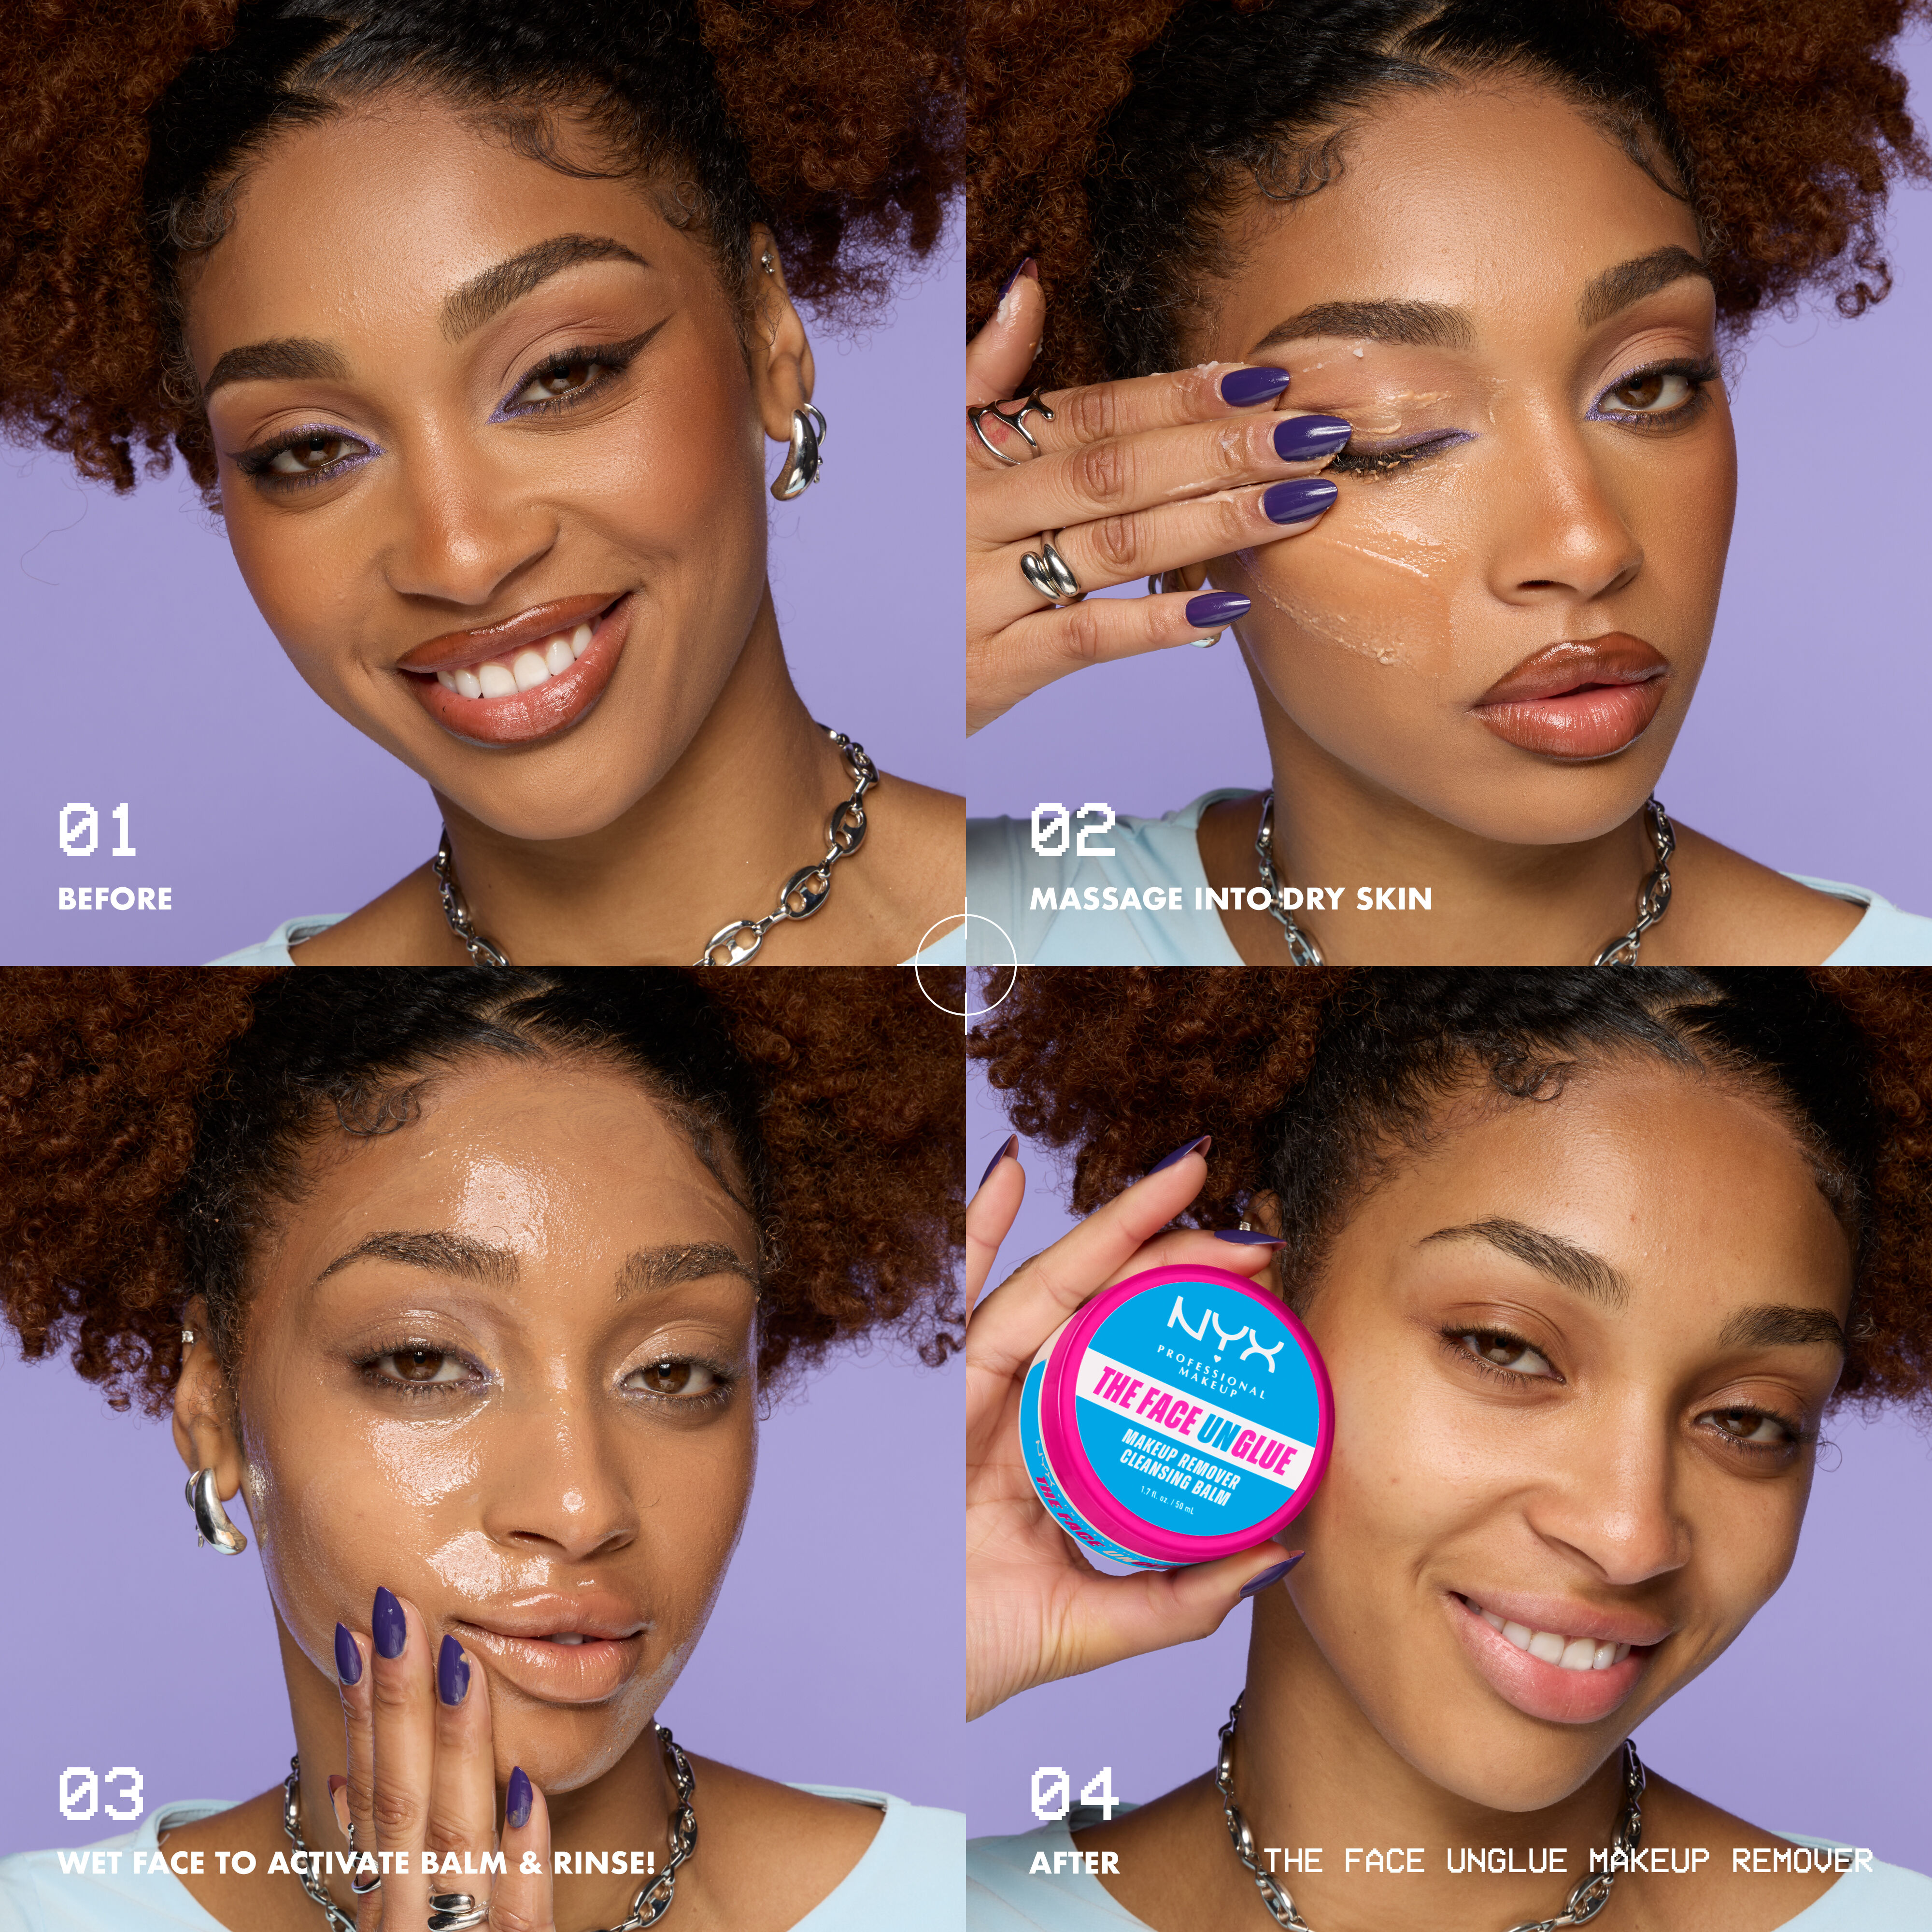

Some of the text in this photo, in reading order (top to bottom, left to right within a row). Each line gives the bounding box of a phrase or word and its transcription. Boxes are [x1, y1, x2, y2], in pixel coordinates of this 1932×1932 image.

[1167, 1295, 1285, 1374] NYX
[1157, 1344, 1265, 1400] PROFESSIONAL
[1178, 1366, 1237, 1398] MAKEUP
[1093, 1365, 1298, 1476] THE FACE UNGLUE
[1120, 1449, 1232, 1507] CLEANSING BALM
[1122, 1428, 1241, 1490] MAKEUP REMOVER
[1036, 1476, 1064, 1509] THE
[1056, 1512, 1106, 1548] FACE
[1141, 1486, 1151, 1495] 1.7
[1160, 1496, 1169, 1504] oz.
[1175, 1500, 1184, 1510] 50
[1184, 1506, 1194, 1515] mL
